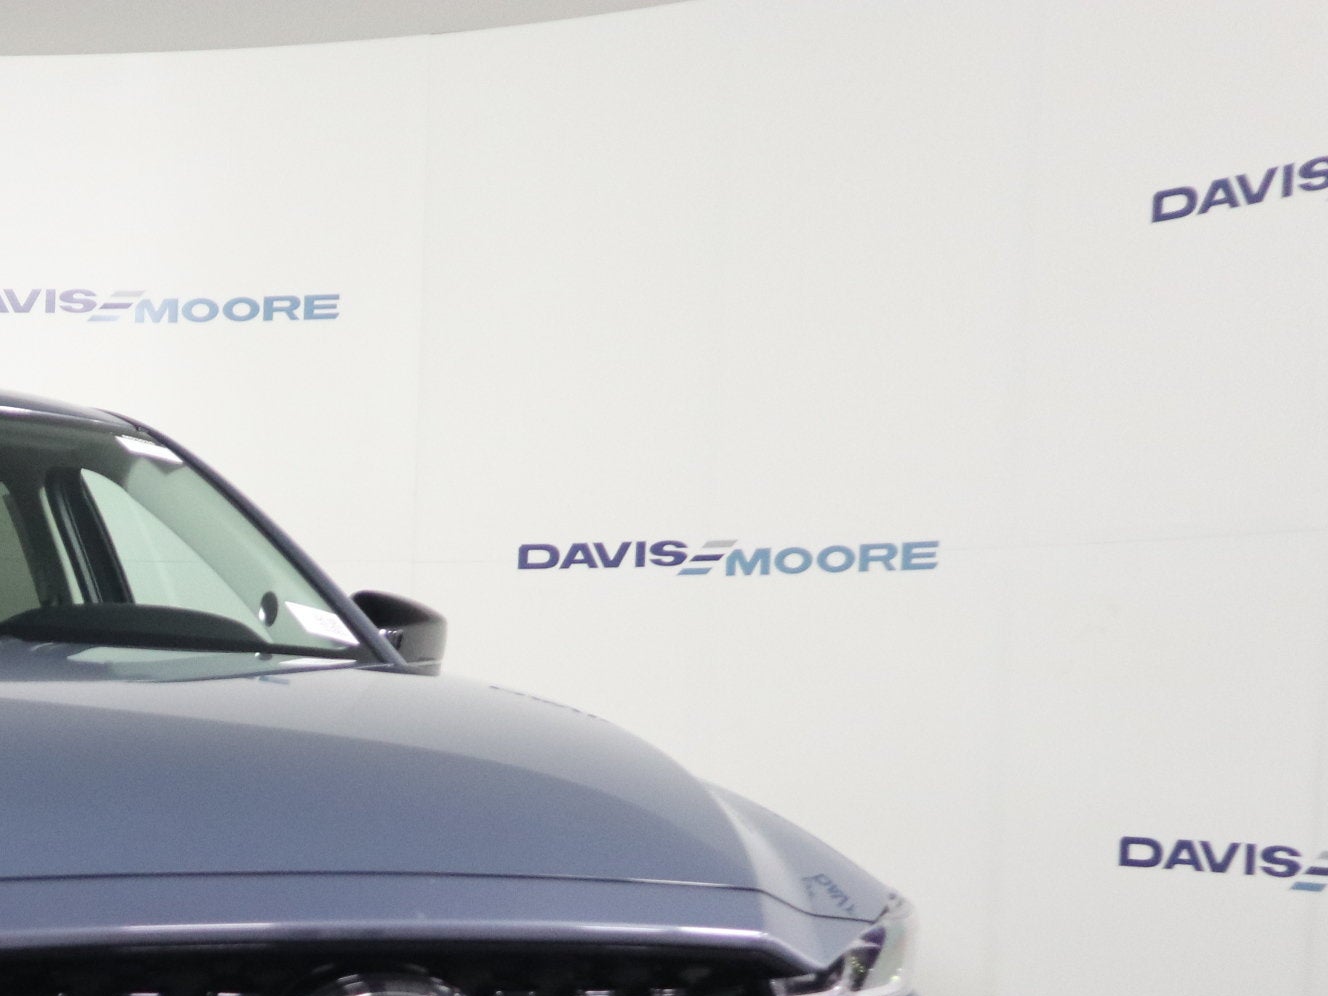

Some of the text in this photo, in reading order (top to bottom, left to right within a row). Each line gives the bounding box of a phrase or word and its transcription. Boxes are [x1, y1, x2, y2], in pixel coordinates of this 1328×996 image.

[1150, 155, 1328, 224] DAVIS
[135, 293, 341, 324] MOORE
[517, 539, 940, 577] DAVIS MOORE
[1117, 835, 1303, 879] DAVIS
